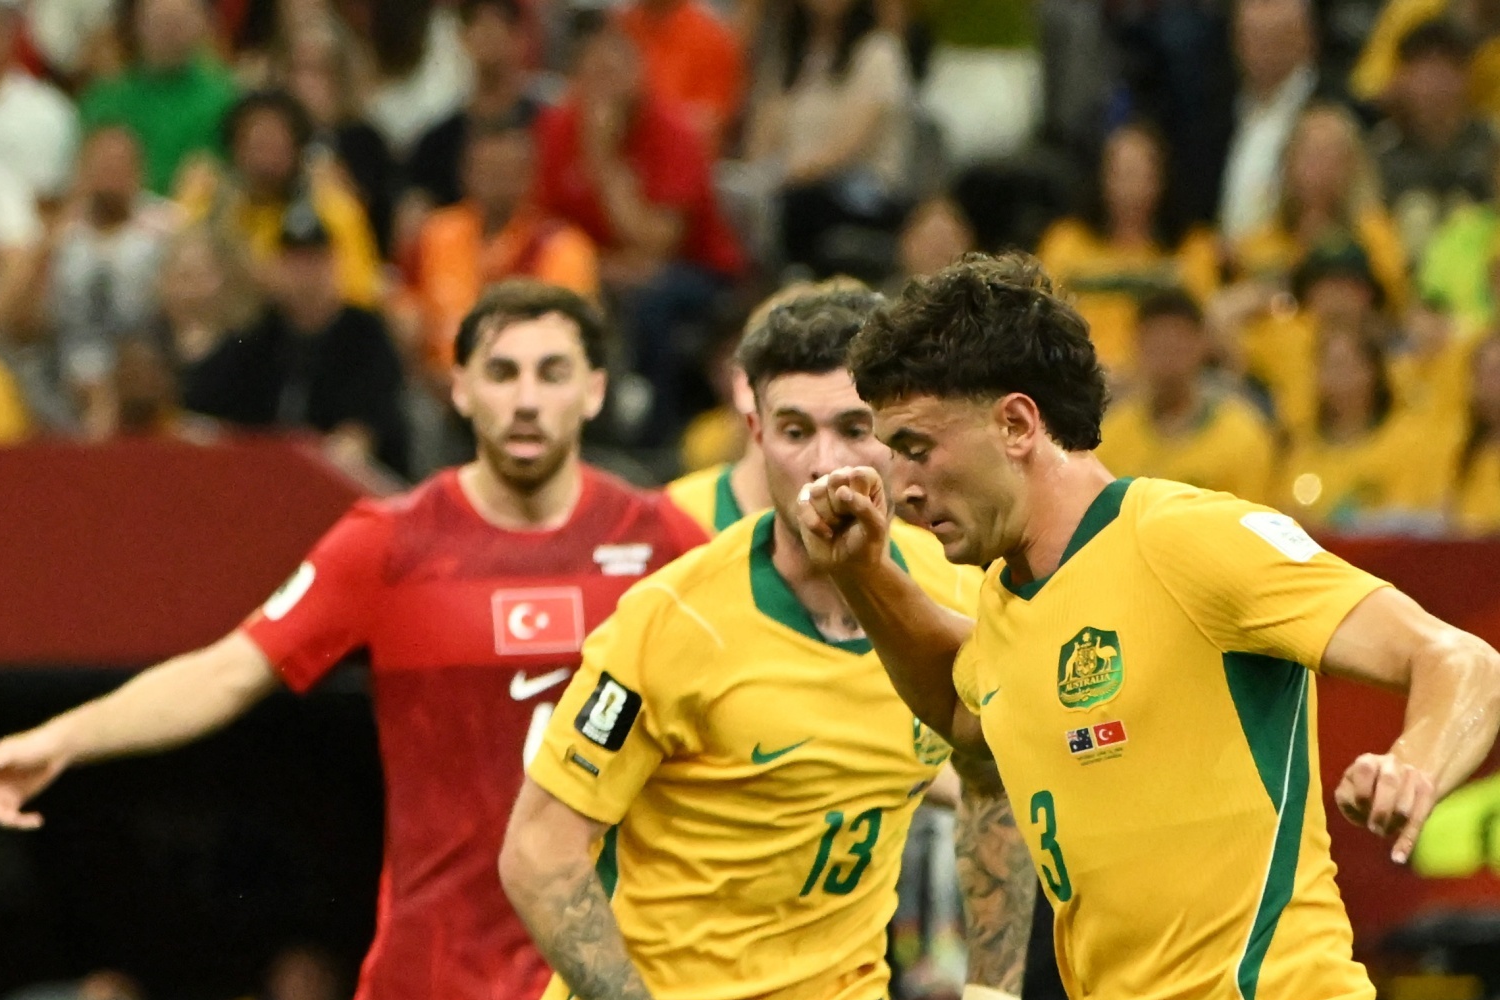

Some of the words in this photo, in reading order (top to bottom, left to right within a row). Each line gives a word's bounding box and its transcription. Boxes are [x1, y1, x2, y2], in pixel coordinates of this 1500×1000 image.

[1065, 673, 1111, 692] AUSTRALIA
[799, 807, 882, 896] 13
[1030, 790, 1072, 902] 3
